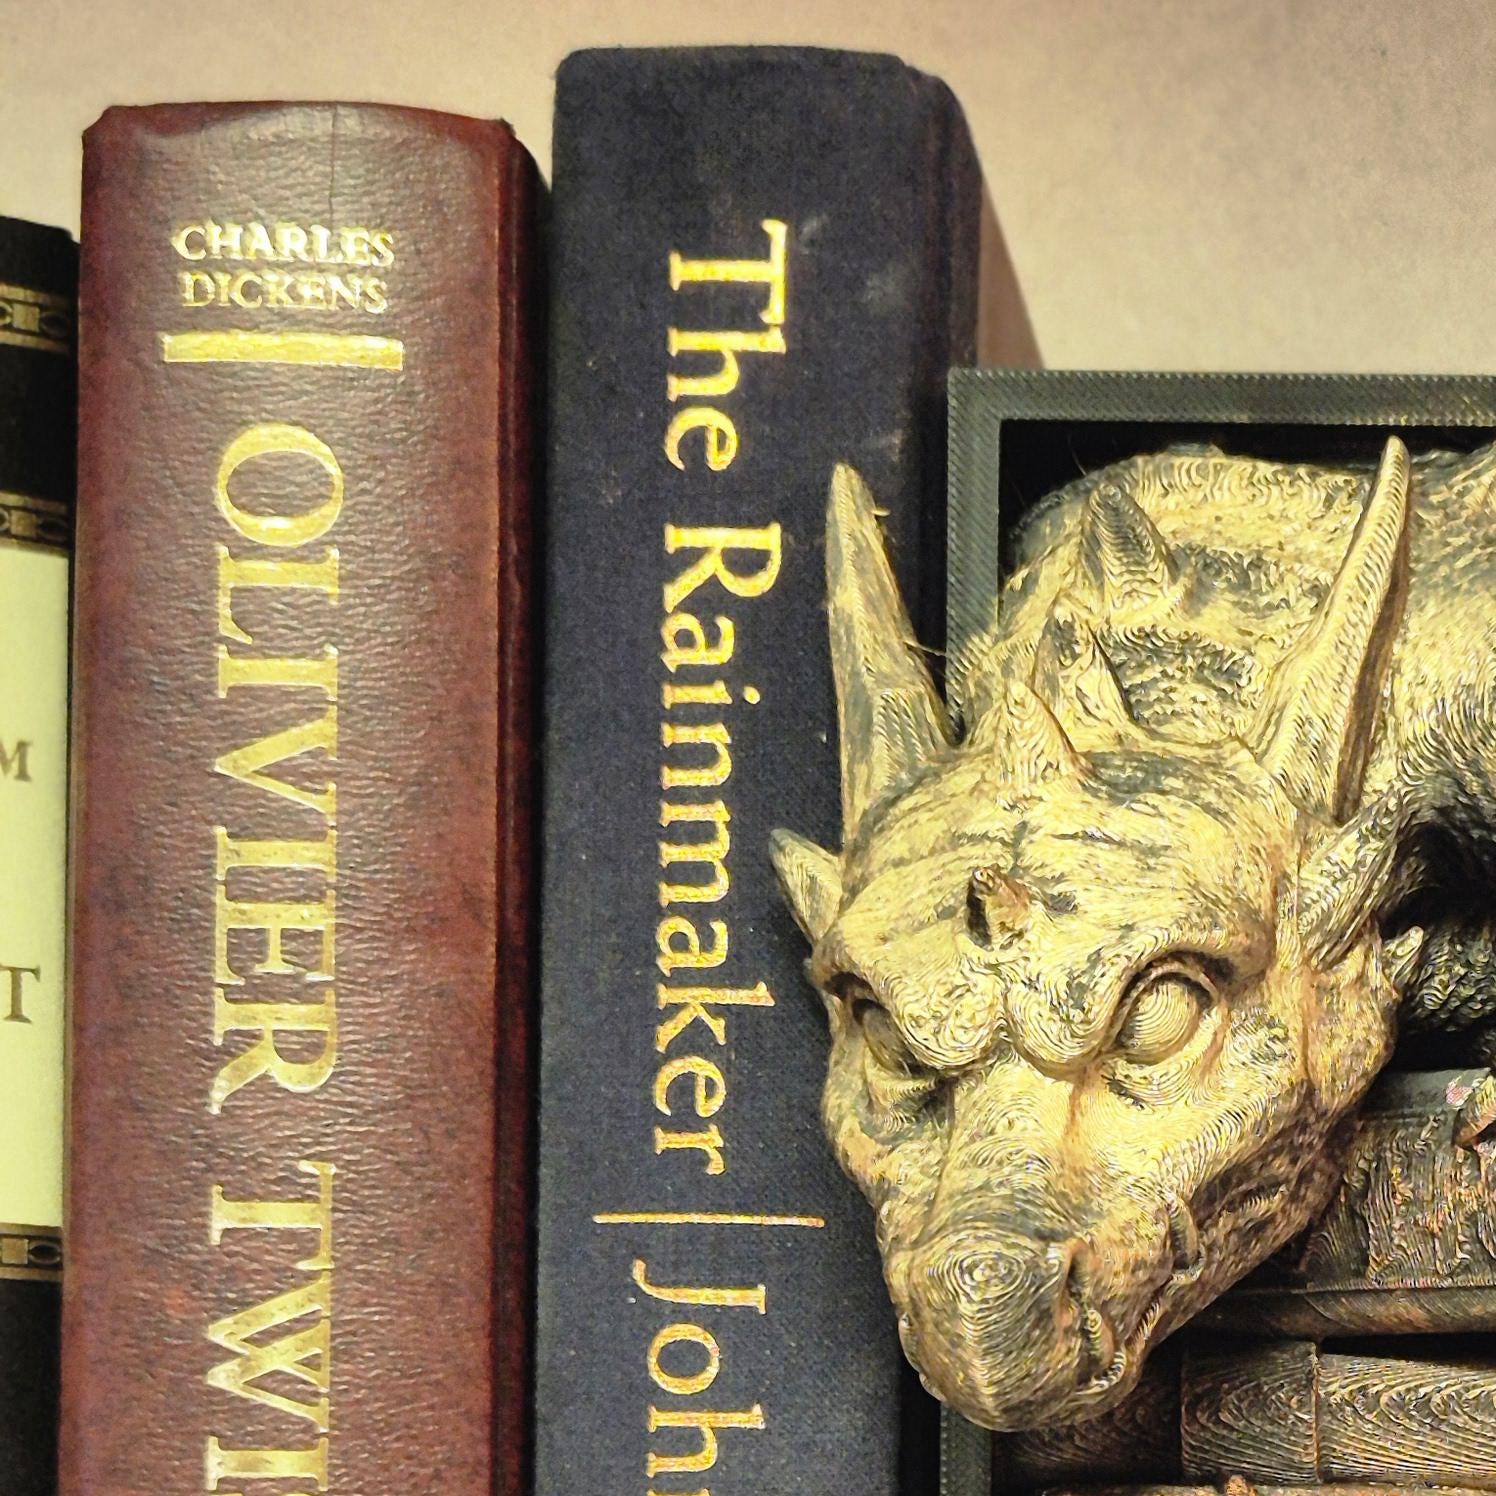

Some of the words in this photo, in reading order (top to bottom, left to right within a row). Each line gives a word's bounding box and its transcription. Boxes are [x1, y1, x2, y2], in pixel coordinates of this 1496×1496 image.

[173, 220, 395, 269] CHARLES
[179, 271, 390, 315] DICKENS
[664, 218, 788, 472] The
[207, 423, 344, 1115] OLIVER
[654, 521, 783, 1176] Rainmaker
